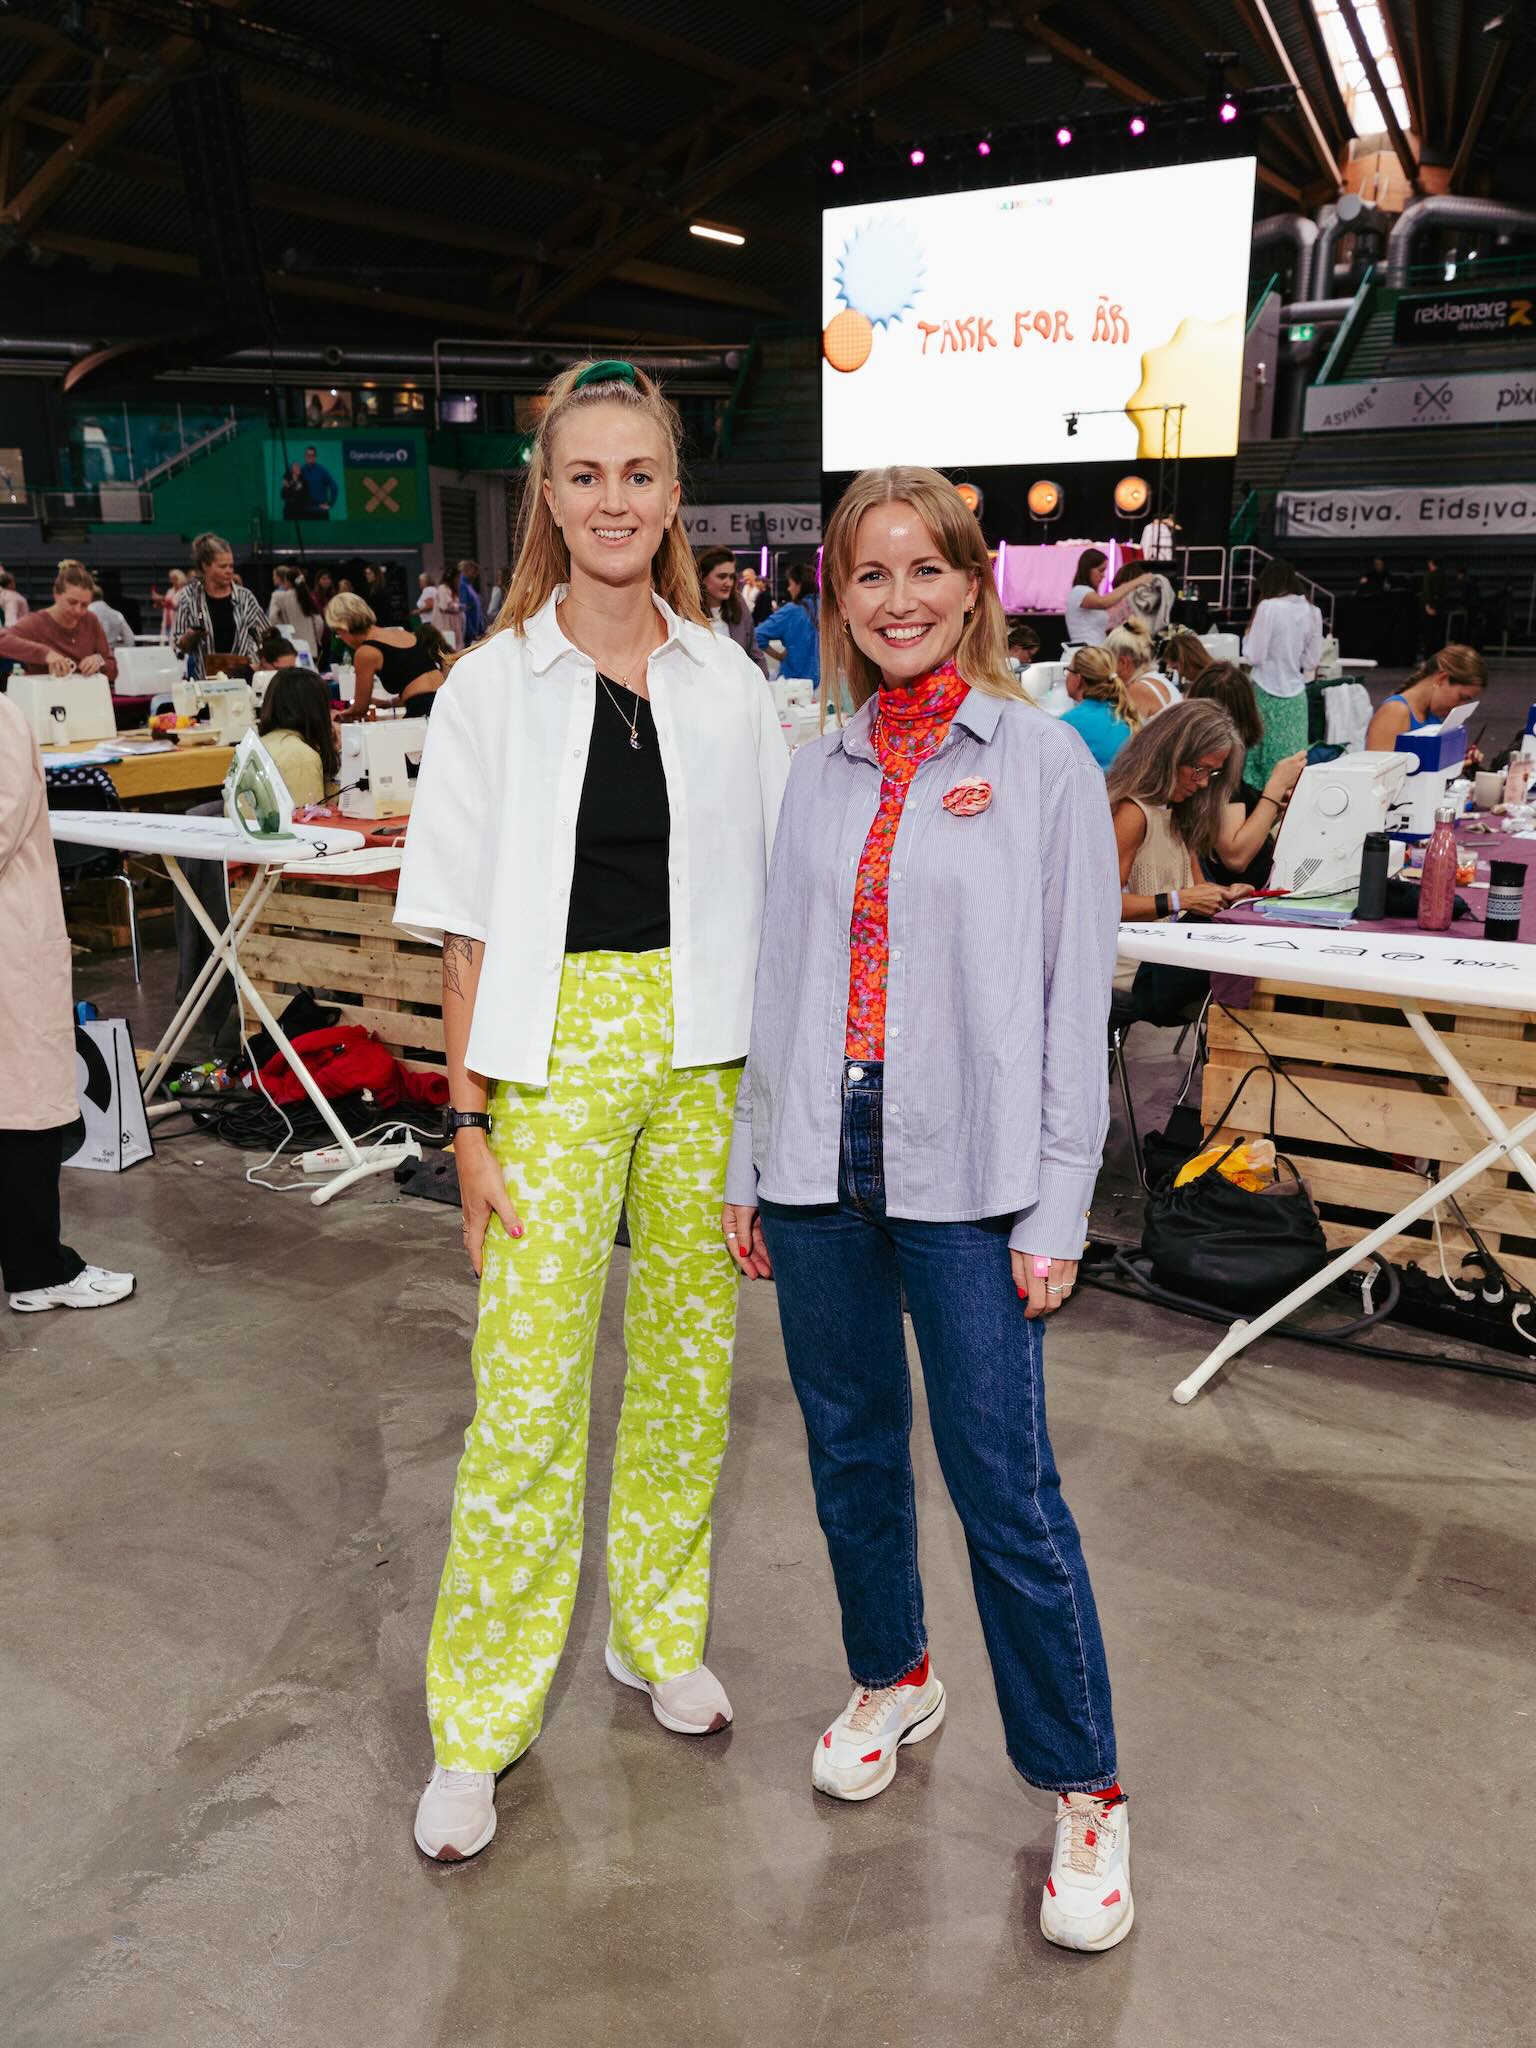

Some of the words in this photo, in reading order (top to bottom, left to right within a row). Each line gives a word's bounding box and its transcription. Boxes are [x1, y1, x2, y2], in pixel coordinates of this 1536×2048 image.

[917, 316, 998, 355] TAKK
[1014, 310, 1074, 348] FOR
[1322, 396, 1376, 427] ASPIRE
